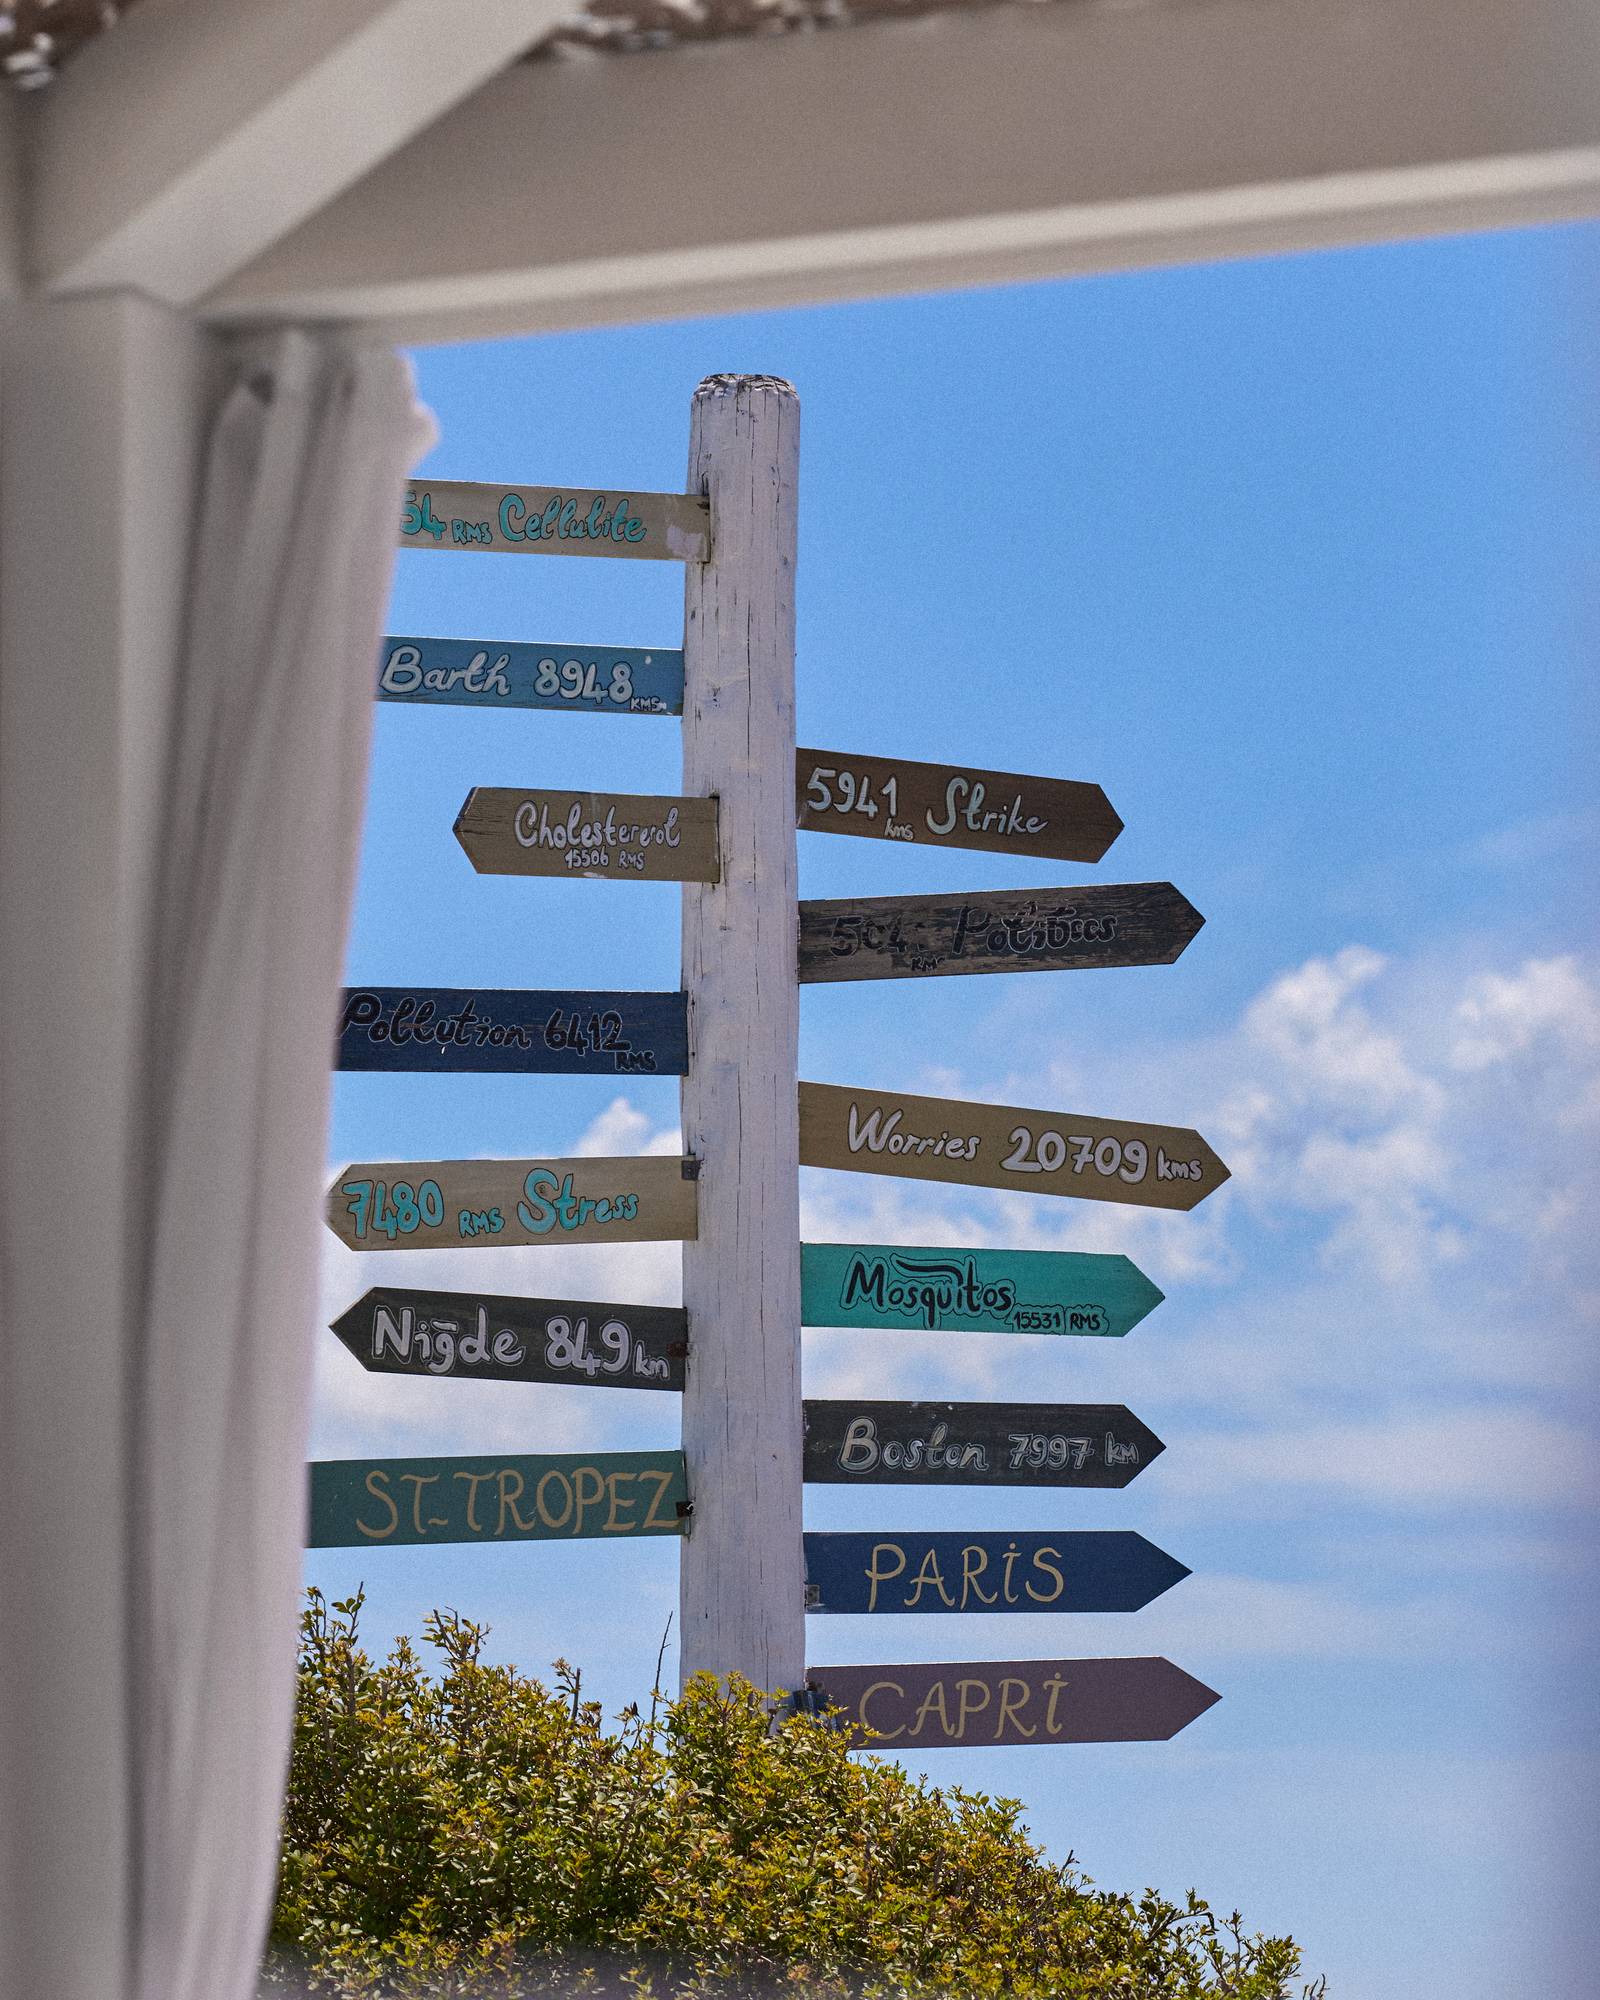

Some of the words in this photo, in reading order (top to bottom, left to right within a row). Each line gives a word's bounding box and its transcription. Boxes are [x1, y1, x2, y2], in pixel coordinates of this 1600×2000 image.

[498, 493, 647, 542] Cellulite
[380, 645, 512, 696] Barth
[533, 657, 634, 704] 8948
[807, 767, 899, 818] 5941
[925, 775, 1049, 836] Strike
[564, 845, 609, 871] 15506
[338, 992, 532, 1048] Pollution
[544, 1008, 633, 1057] 6412
[847, 1102, 981, 1162] Worries
[1000, 1126, 1149, 1184] 20709
[1155, 1146, 1203, 1182] kms
[341, 1178, 445, 1240] 7480
[516, 1167, 640, 1236] Stress
[842, 1253, 1014, 1330] Mosquitos
[545, 1315, 631, 1376] 849
[633, 1340, 670, 1381] km
[838, 1416, 989, 1474] Boston
[1008, 1433, 1095, 1470] 7997
